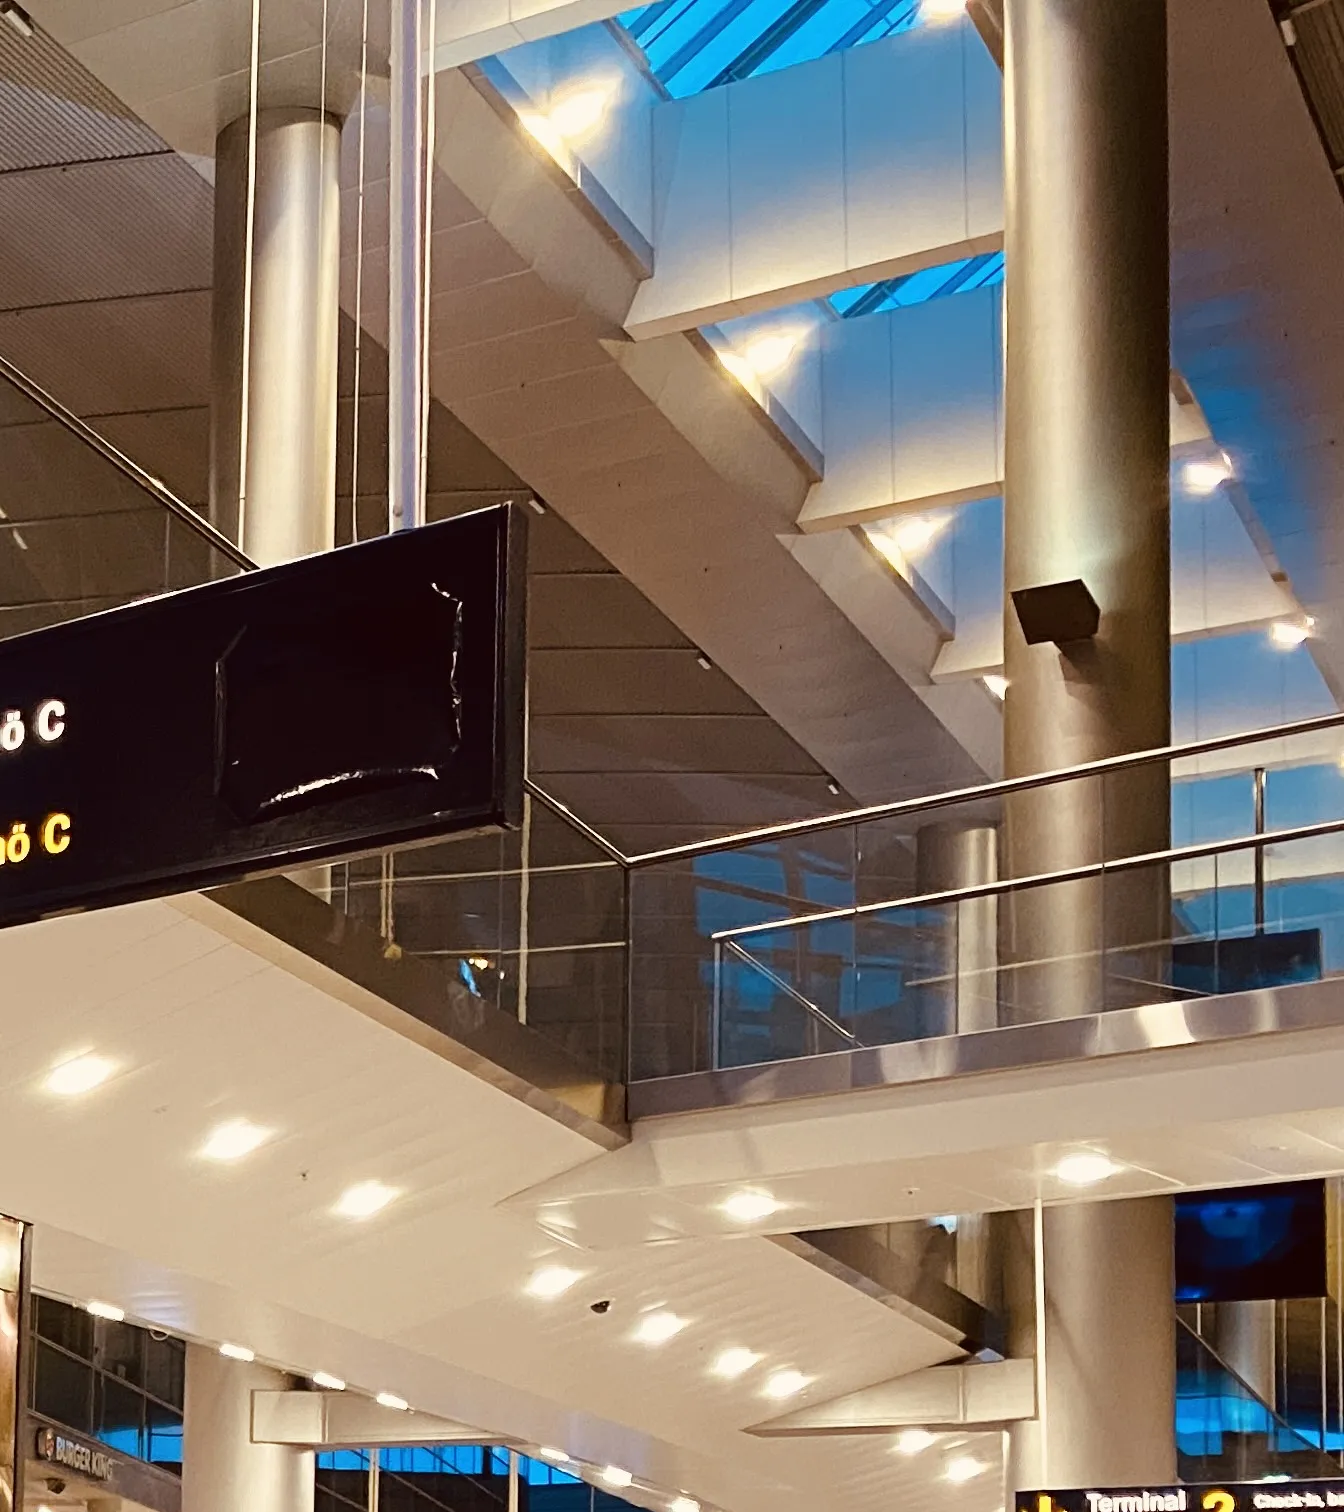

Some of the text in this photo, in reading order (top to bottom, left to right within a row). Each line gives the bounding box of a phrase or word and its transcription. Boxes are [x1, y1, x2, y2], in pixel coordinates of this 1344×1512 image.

[37, 699, 66, 742] C
[43, 812, 72, 854] C
[55, 1436, 113, 1481] BURGER KING
